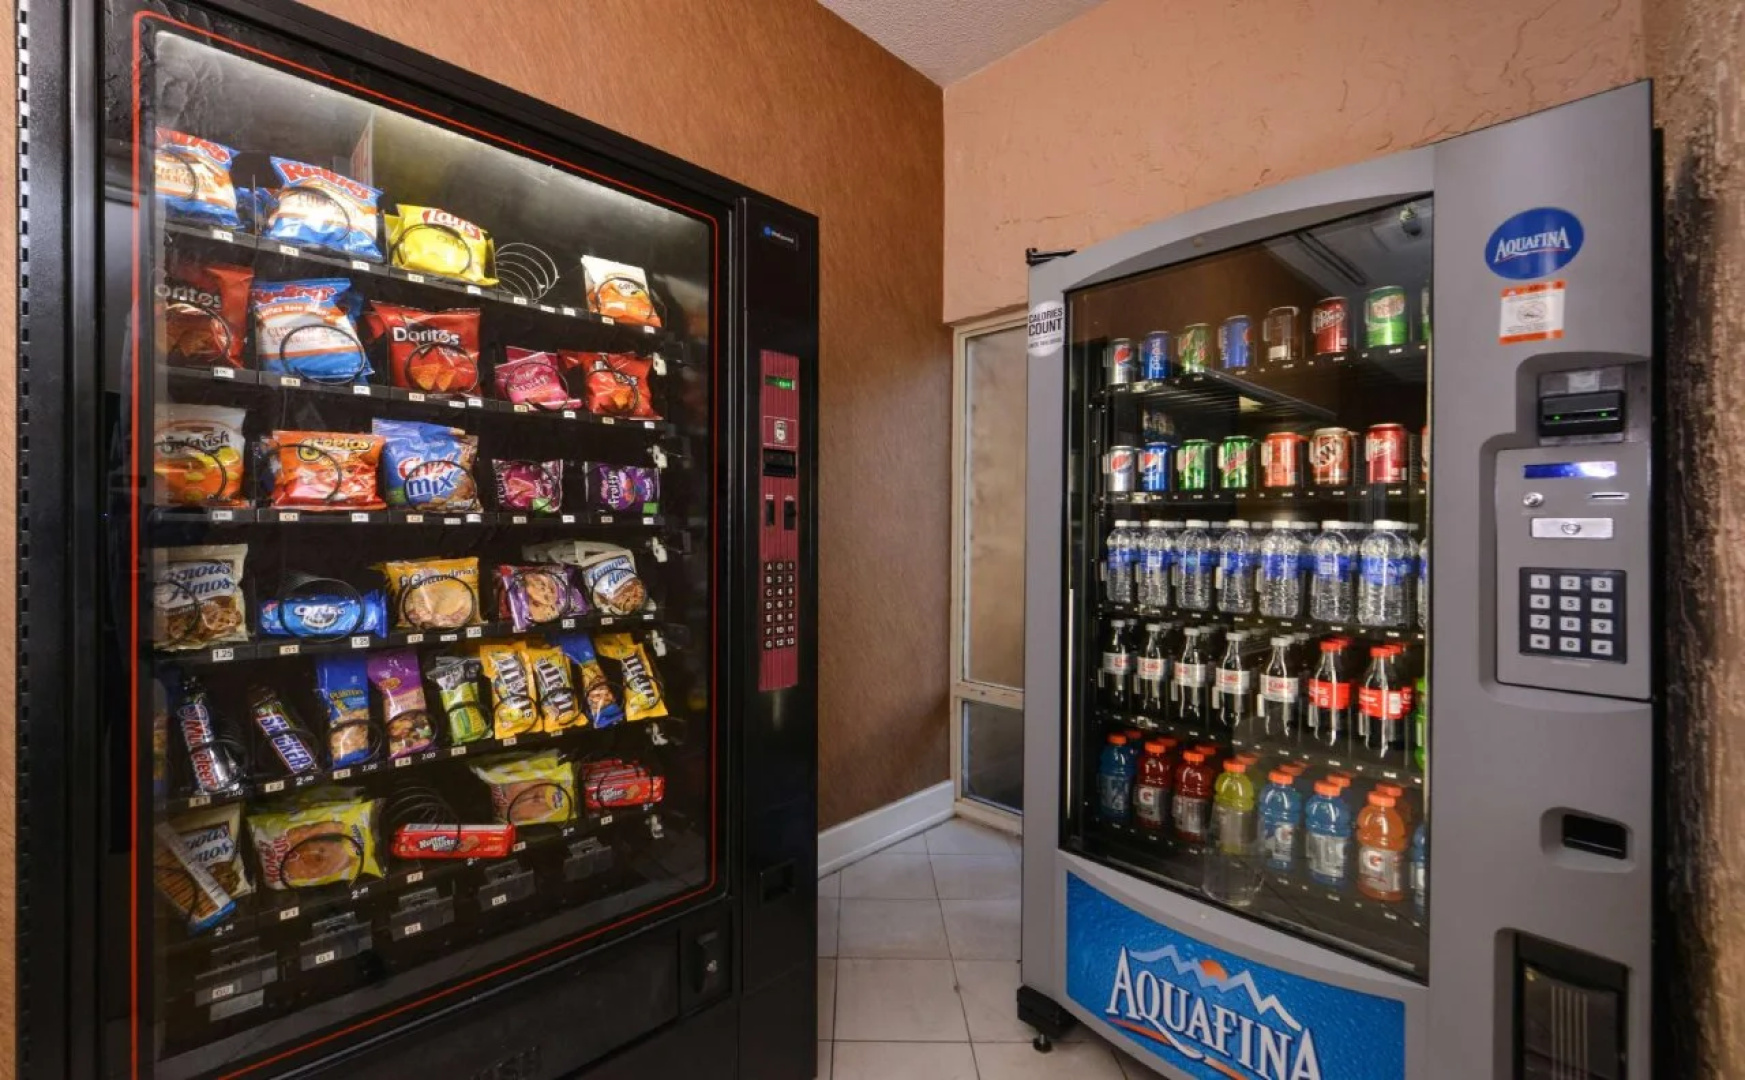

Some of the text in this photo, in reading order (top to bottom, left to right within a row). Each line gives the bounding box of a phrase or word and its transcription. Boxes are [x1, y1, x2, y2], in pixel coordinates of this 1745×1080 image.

[1494, 226, 1571, 263] AQUAFINA
[154, 284, 222, 309] oritos
[393, 326, 460, 346] Doritos
[1029, 318, 1063, 336] COUNT
[214, 650, 233, 659] 1.25
[1105, 945, 1322, 1080] AQUAFINA
